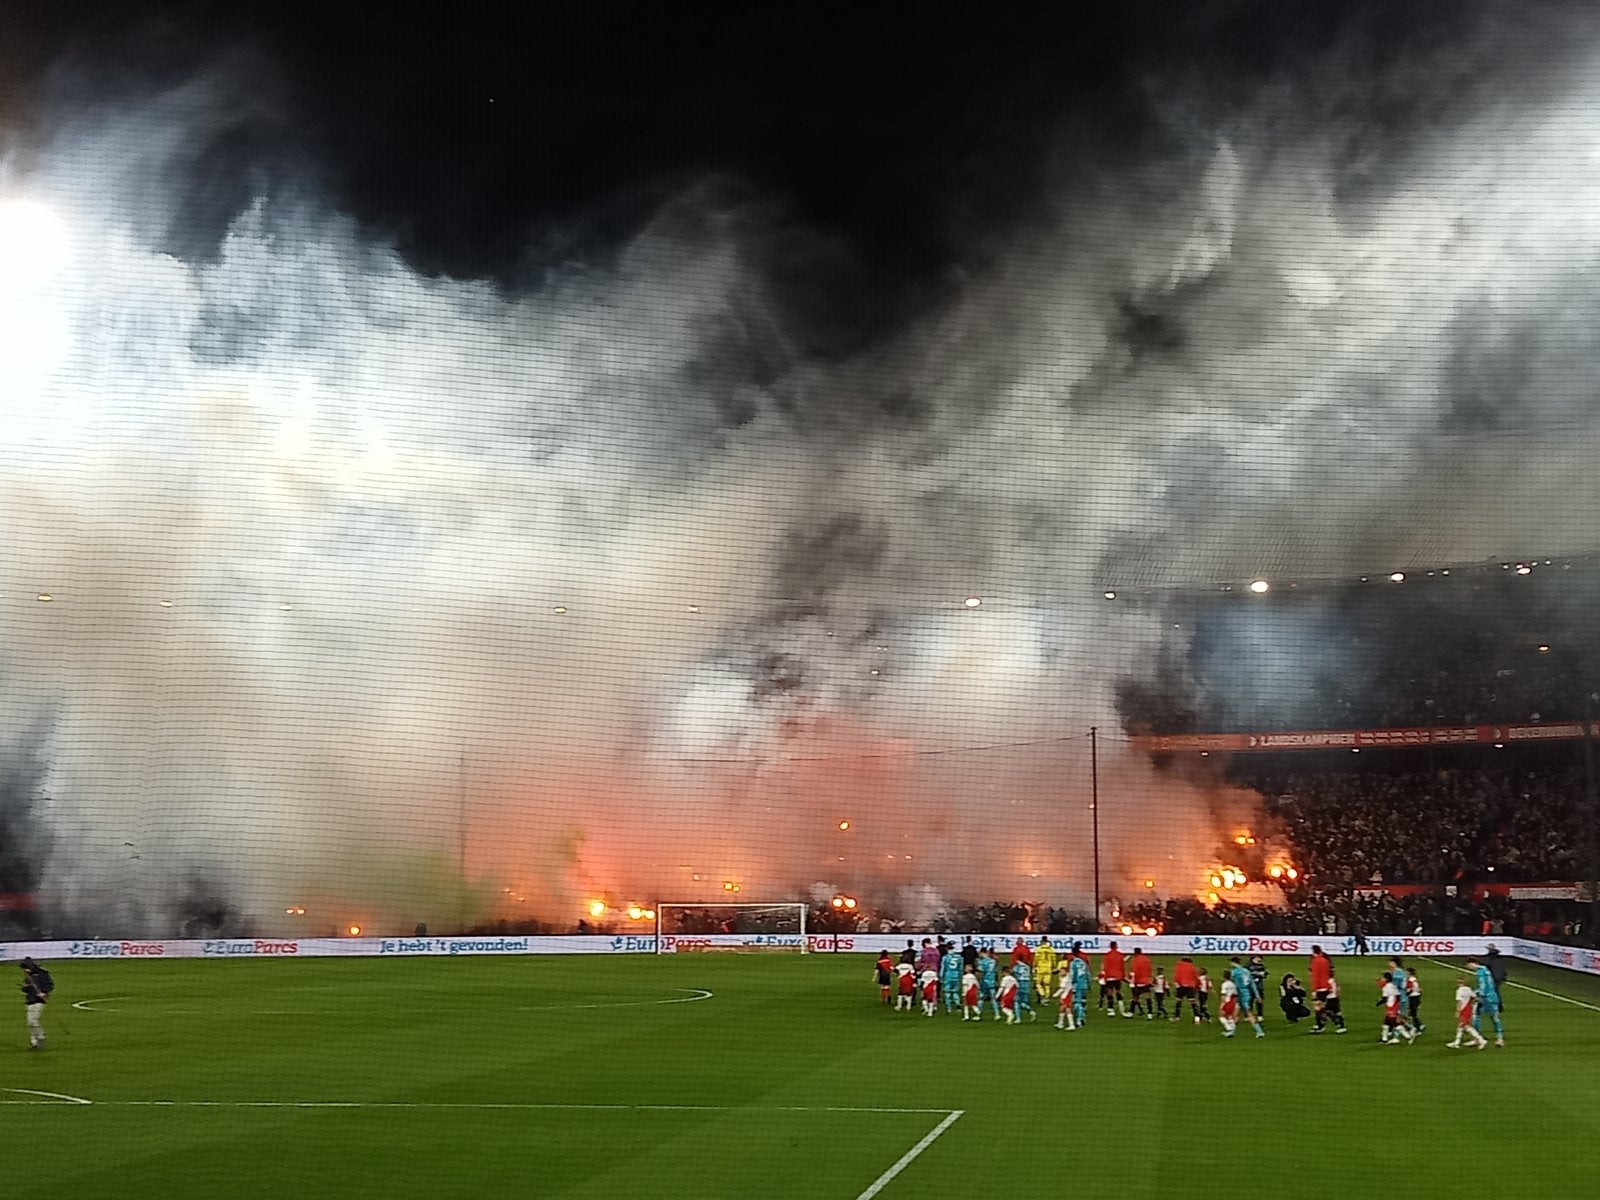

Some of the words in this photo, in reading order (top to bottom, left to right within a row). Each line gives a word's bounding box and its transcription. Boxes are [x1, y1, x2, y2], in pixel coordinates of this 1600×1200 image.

[82, 942, 164, 956] EuroParcs
[216, 940, 298, 954] EuroParcs
[380, 940, 396, 953] Je
[399, 939, 433, 952] hebt
[449, 938, 529, 955] gevonden!
[767, 936, 854, 950] EurParcs
[1204, 937, 1299, 951] EuroParcs
[1363, 938, 1454, 952] uroParcs
